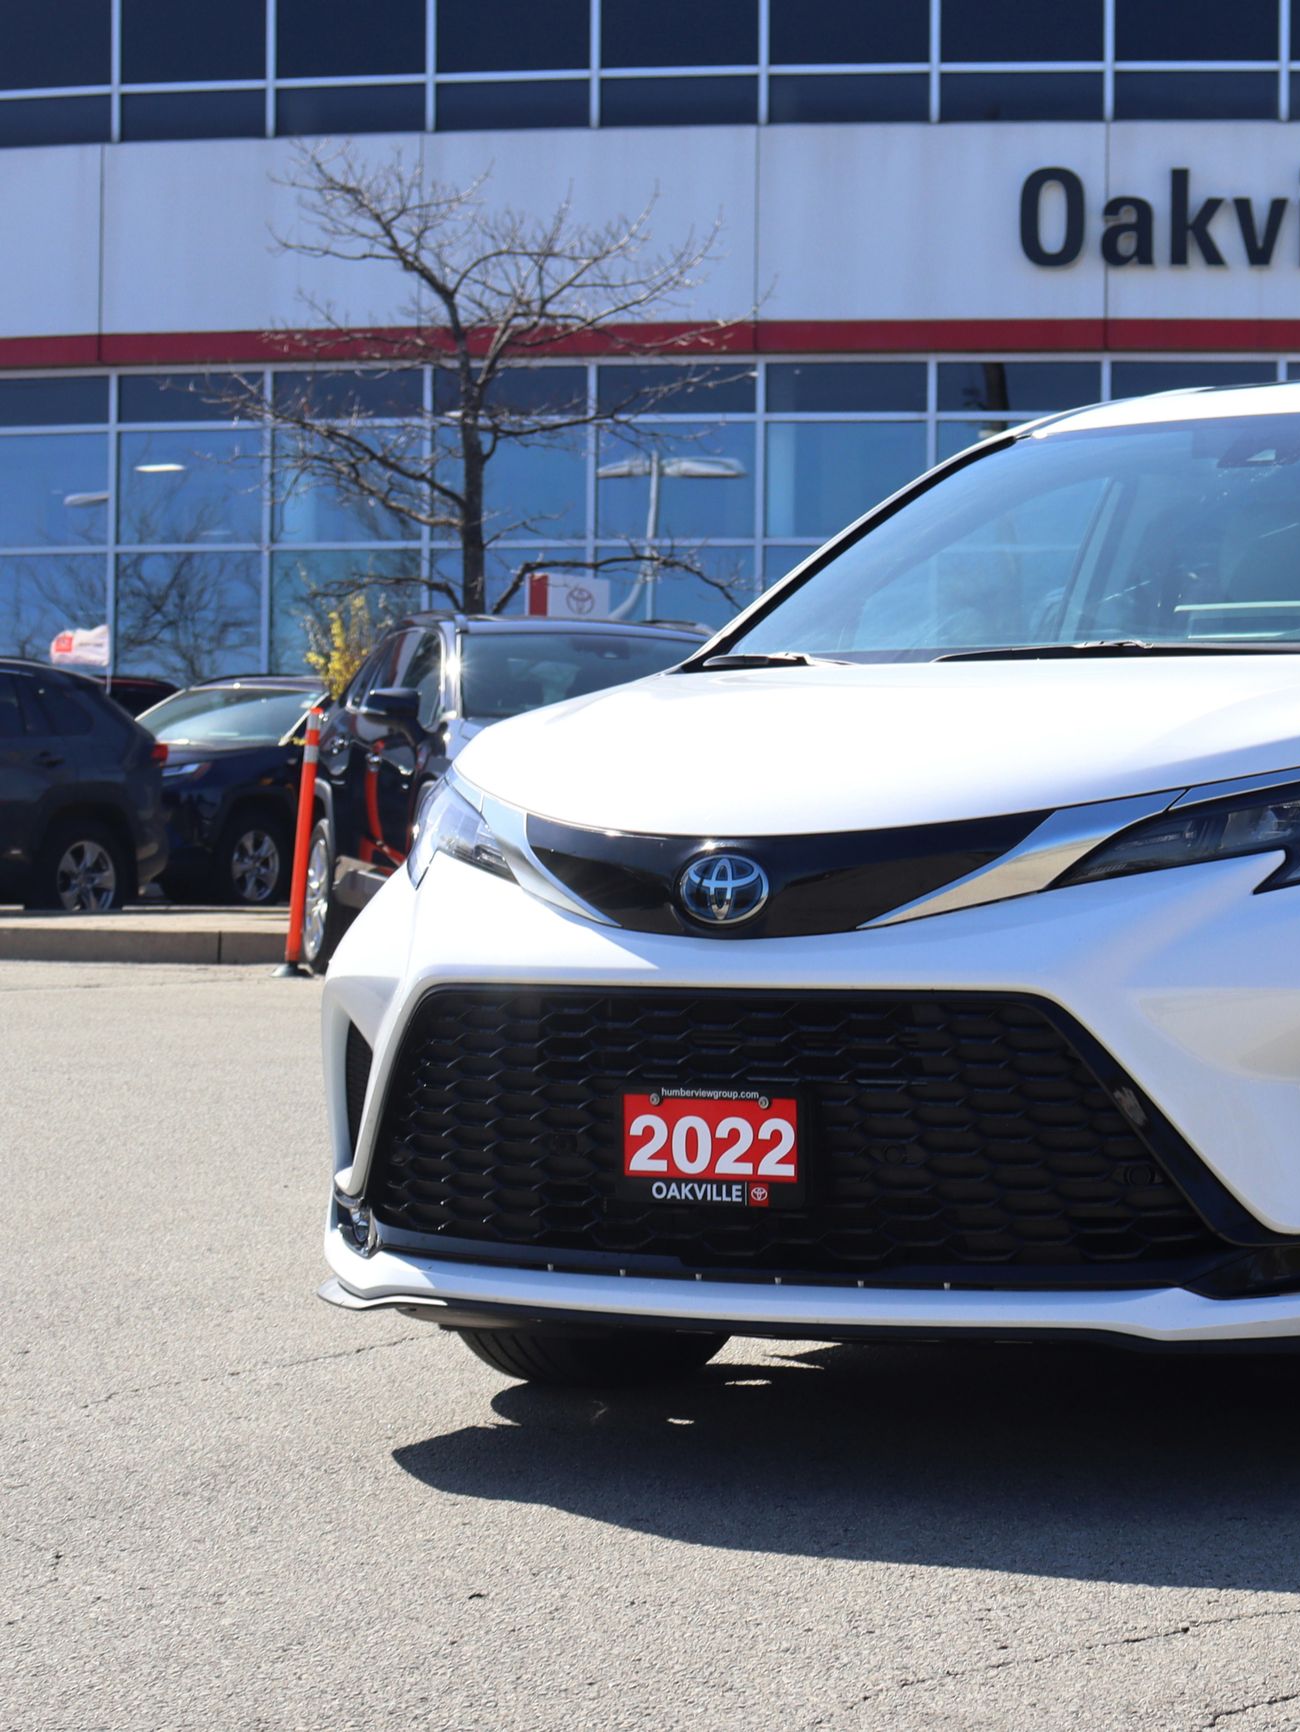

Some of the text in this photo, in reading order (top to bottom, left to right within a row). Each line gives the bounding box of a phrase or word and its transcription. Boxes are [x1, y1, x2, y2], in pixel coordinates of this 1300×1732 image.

[661, 1087, 759, 1100] humberviewgroup.com
[628, 1113, 796, 1177] 2022
[651, 1181, 743, 1202] OAKVILLE
